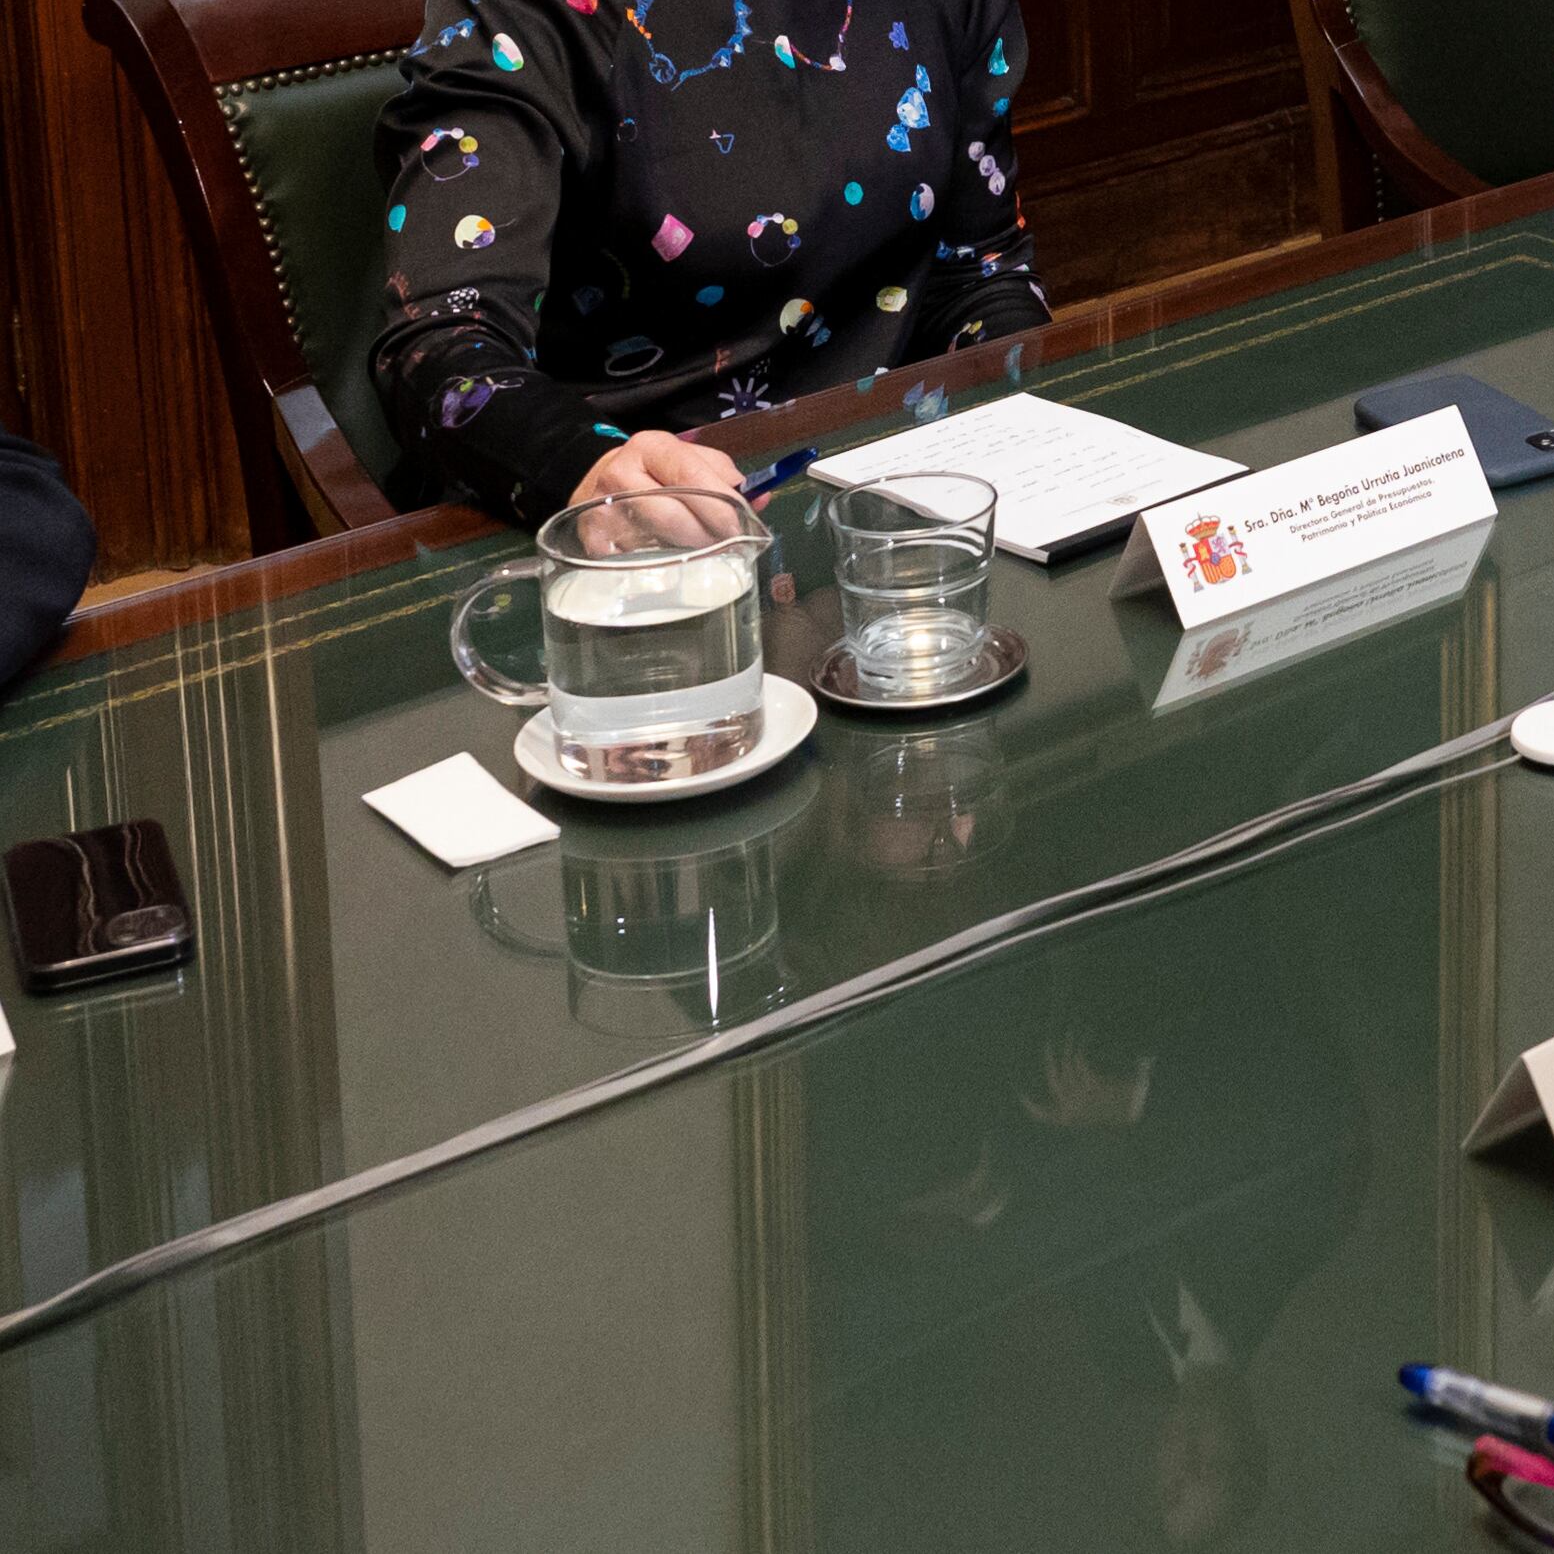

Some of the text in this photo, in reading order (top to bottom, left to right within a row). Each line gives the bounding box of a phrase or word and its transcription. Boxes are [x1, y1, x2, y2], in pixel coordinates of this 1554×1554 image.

[1244, 515, 1269, 534] Sra.
[1270, 506, 1298, 525] Dña.
[1317, 483, 1360, 508] Begoña
[1361, 467, 1401, 491] Urrutia
[1403, 447, 1466, 478] Juanicotena
[1289, 514, 1329, 535] Directora
[1330, 501, 1365, 519] General
[1366, 497, 1377, 508] de
[1301, 520, 1349, 543] Patrimonio
[1349, 517, 1356, 528] y
[1357, 504, 1388, 523] Política
